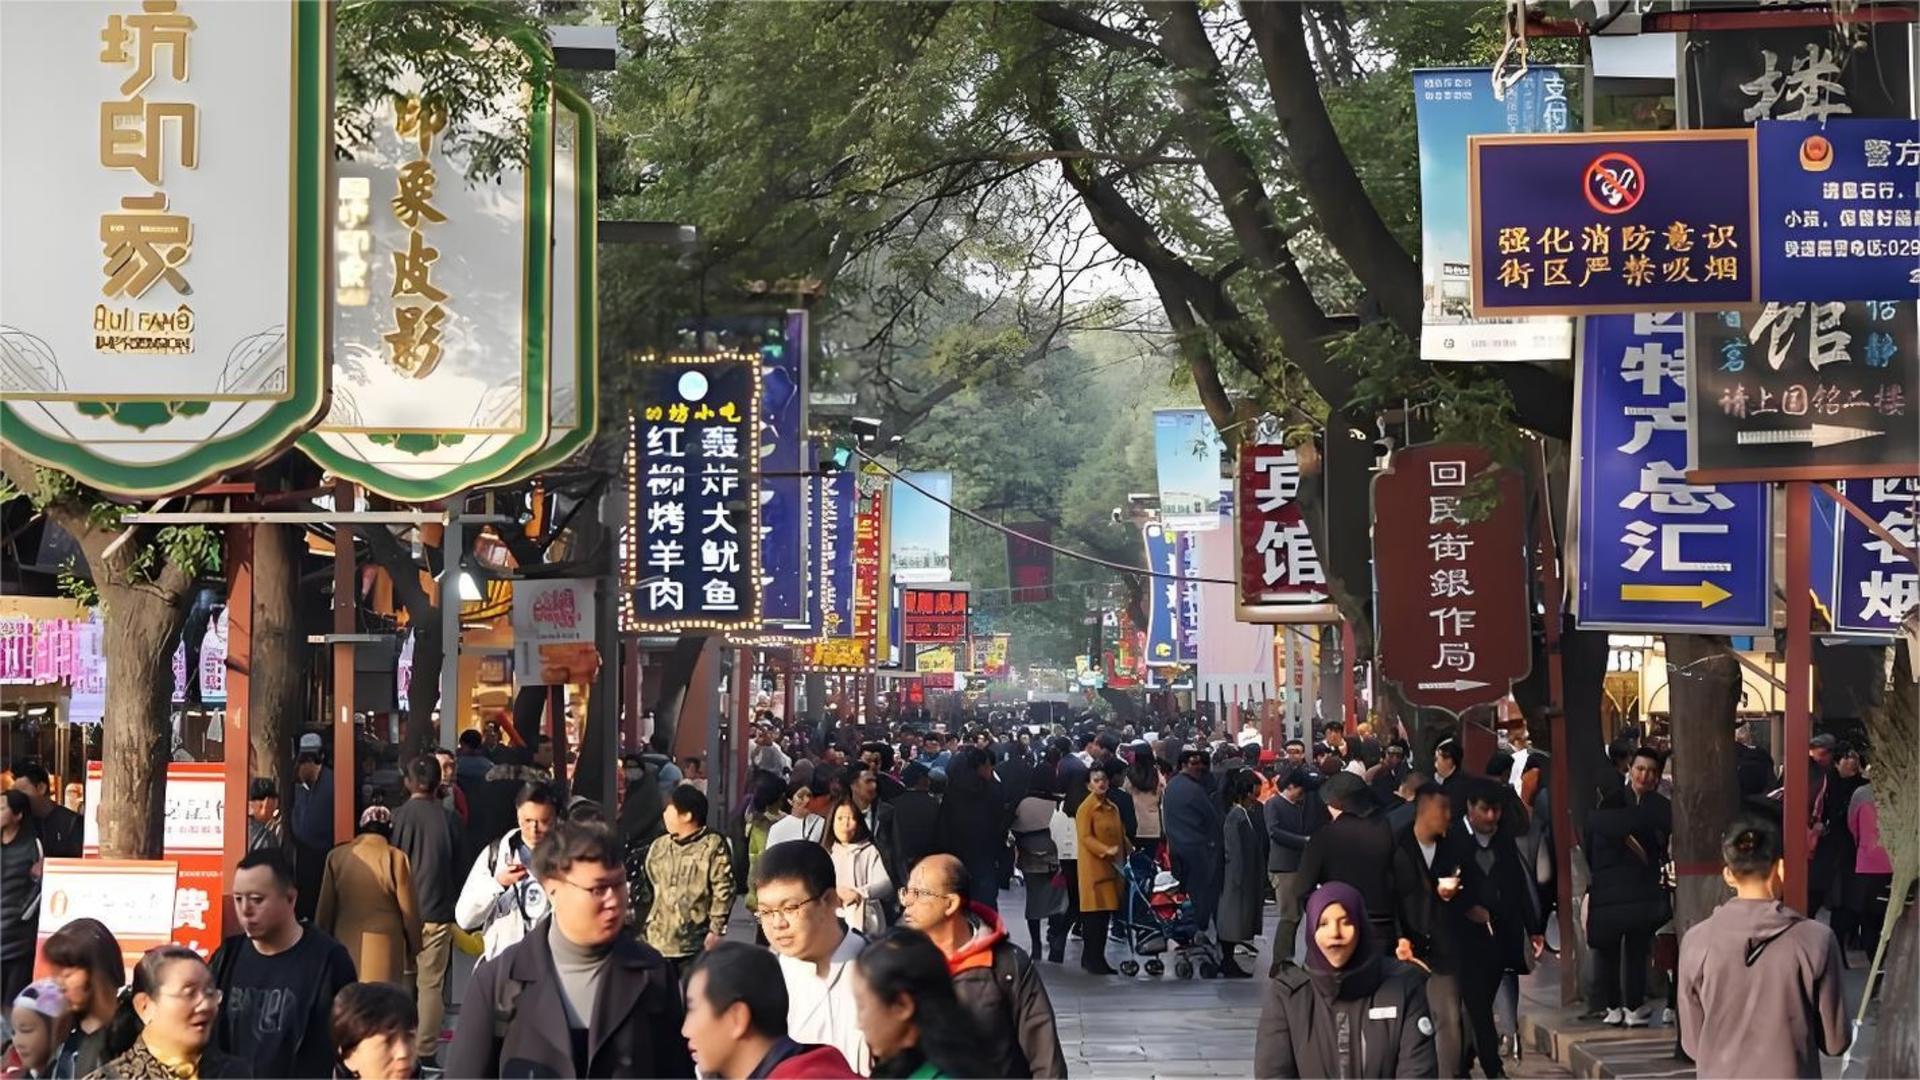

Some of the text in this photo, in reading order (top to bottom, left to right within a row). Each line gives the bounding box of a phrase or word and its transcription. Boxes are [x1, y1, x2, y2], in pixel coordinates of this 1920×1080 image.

[1499, 220, 1738, 254] 强化消防意识
[1497, 253, 1738, 289] 街区严禁吸烟
[1254, 450, 1326, 586] 宾馆
